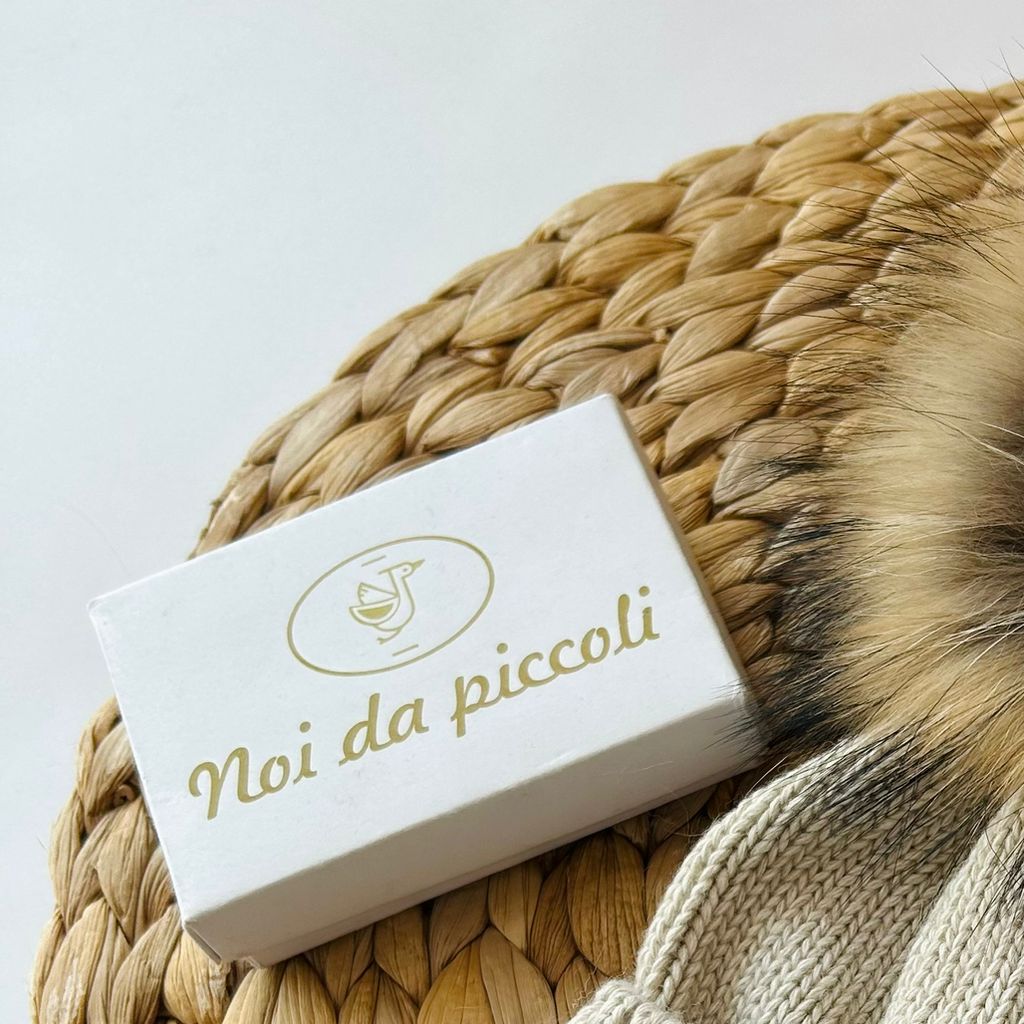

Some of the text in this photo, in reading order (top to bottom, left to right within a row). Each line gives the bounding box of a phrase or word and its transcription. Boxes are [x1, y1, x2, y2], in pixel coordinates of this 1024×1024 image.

[187, 585, 660, 821] Noi da piccoli
